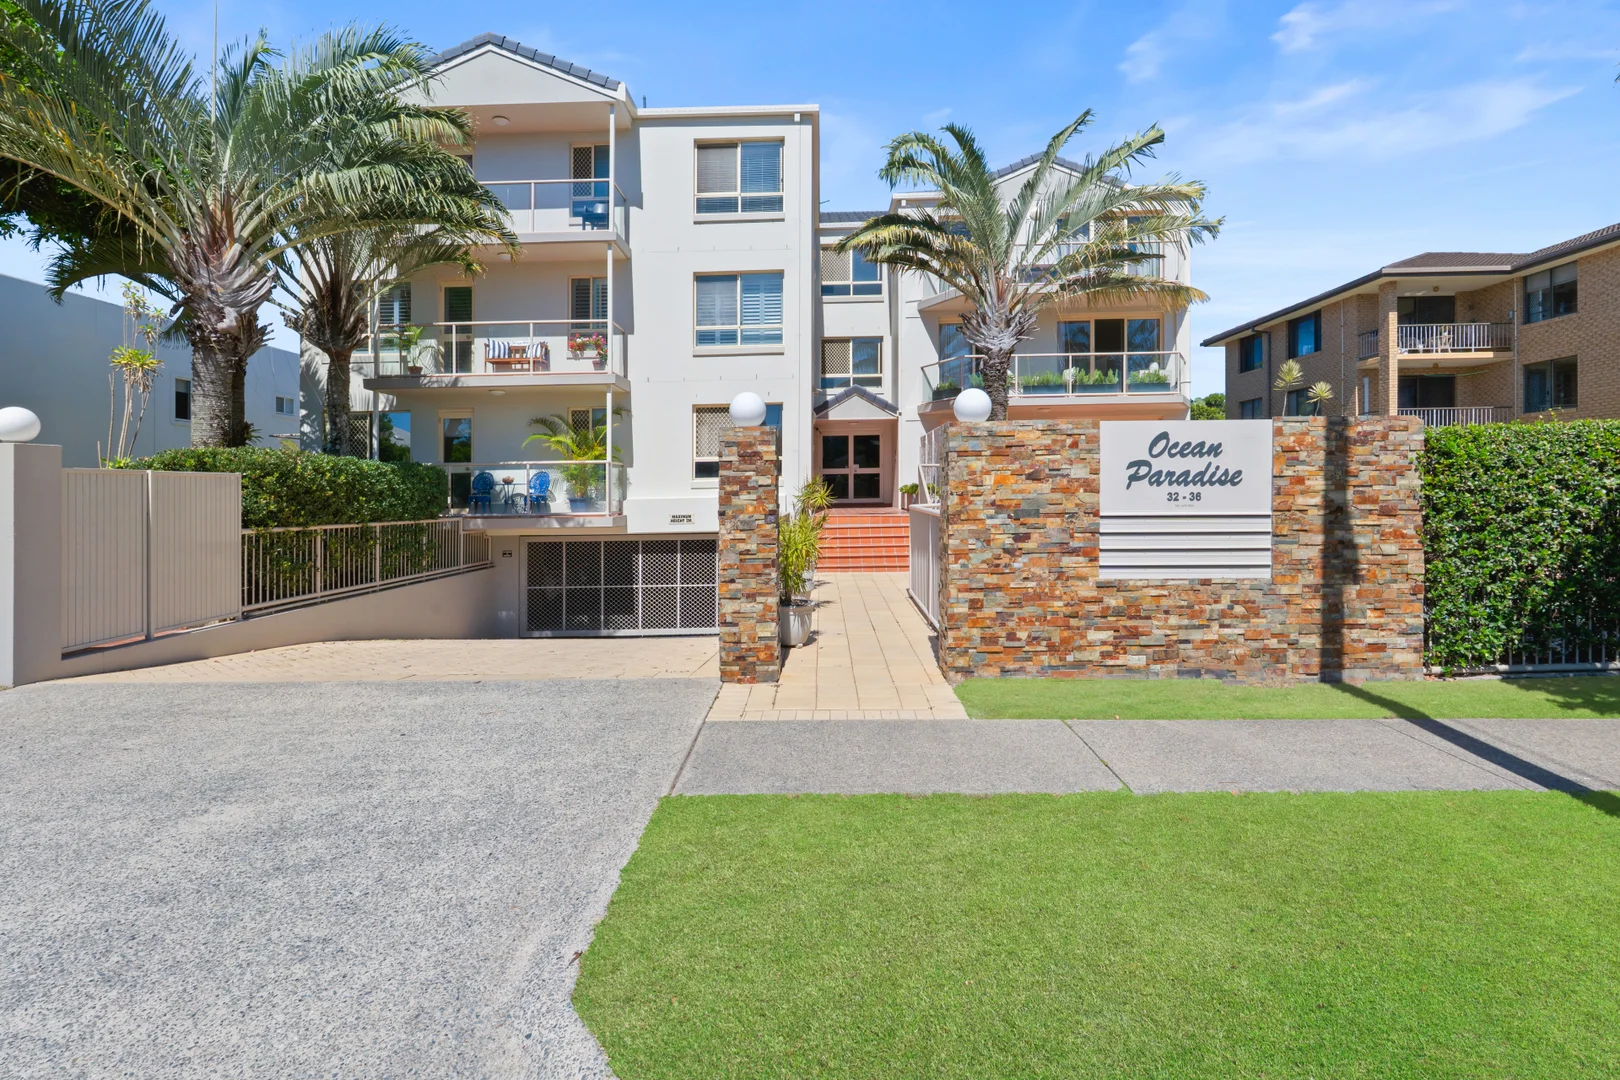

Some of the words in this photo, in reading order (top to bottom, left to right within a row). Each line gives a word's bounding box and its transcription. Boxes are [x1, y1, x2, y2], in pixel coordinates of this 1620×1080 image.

[1148, 431, 1223, 458] Ocean
[1126, 459, 1243, 490] Paradise
[1167, 492, 1179, 501] 32
[1189, 492, 1201, 501] 36
